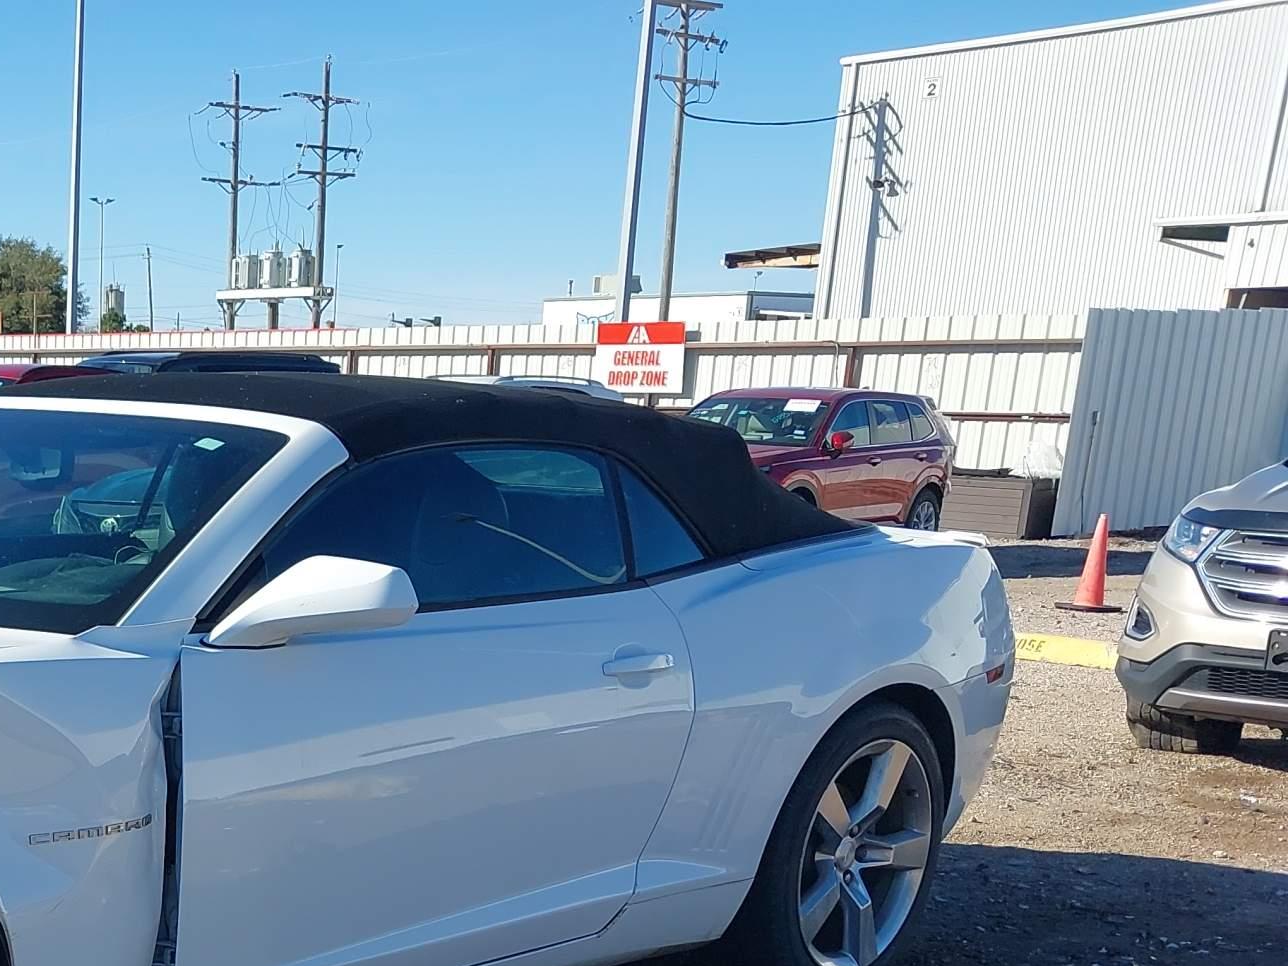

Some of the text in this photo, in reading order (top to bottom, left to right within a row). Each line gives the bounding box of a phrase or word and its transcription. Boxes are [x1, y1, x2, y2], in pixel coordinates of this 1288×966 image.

[927, 82, 937, 97] 2
[613, 350, 661, 366] GENERAL
[607, 370, 669, 387] DROP ZONE
[28, 812, 153, 846] CAMARO
